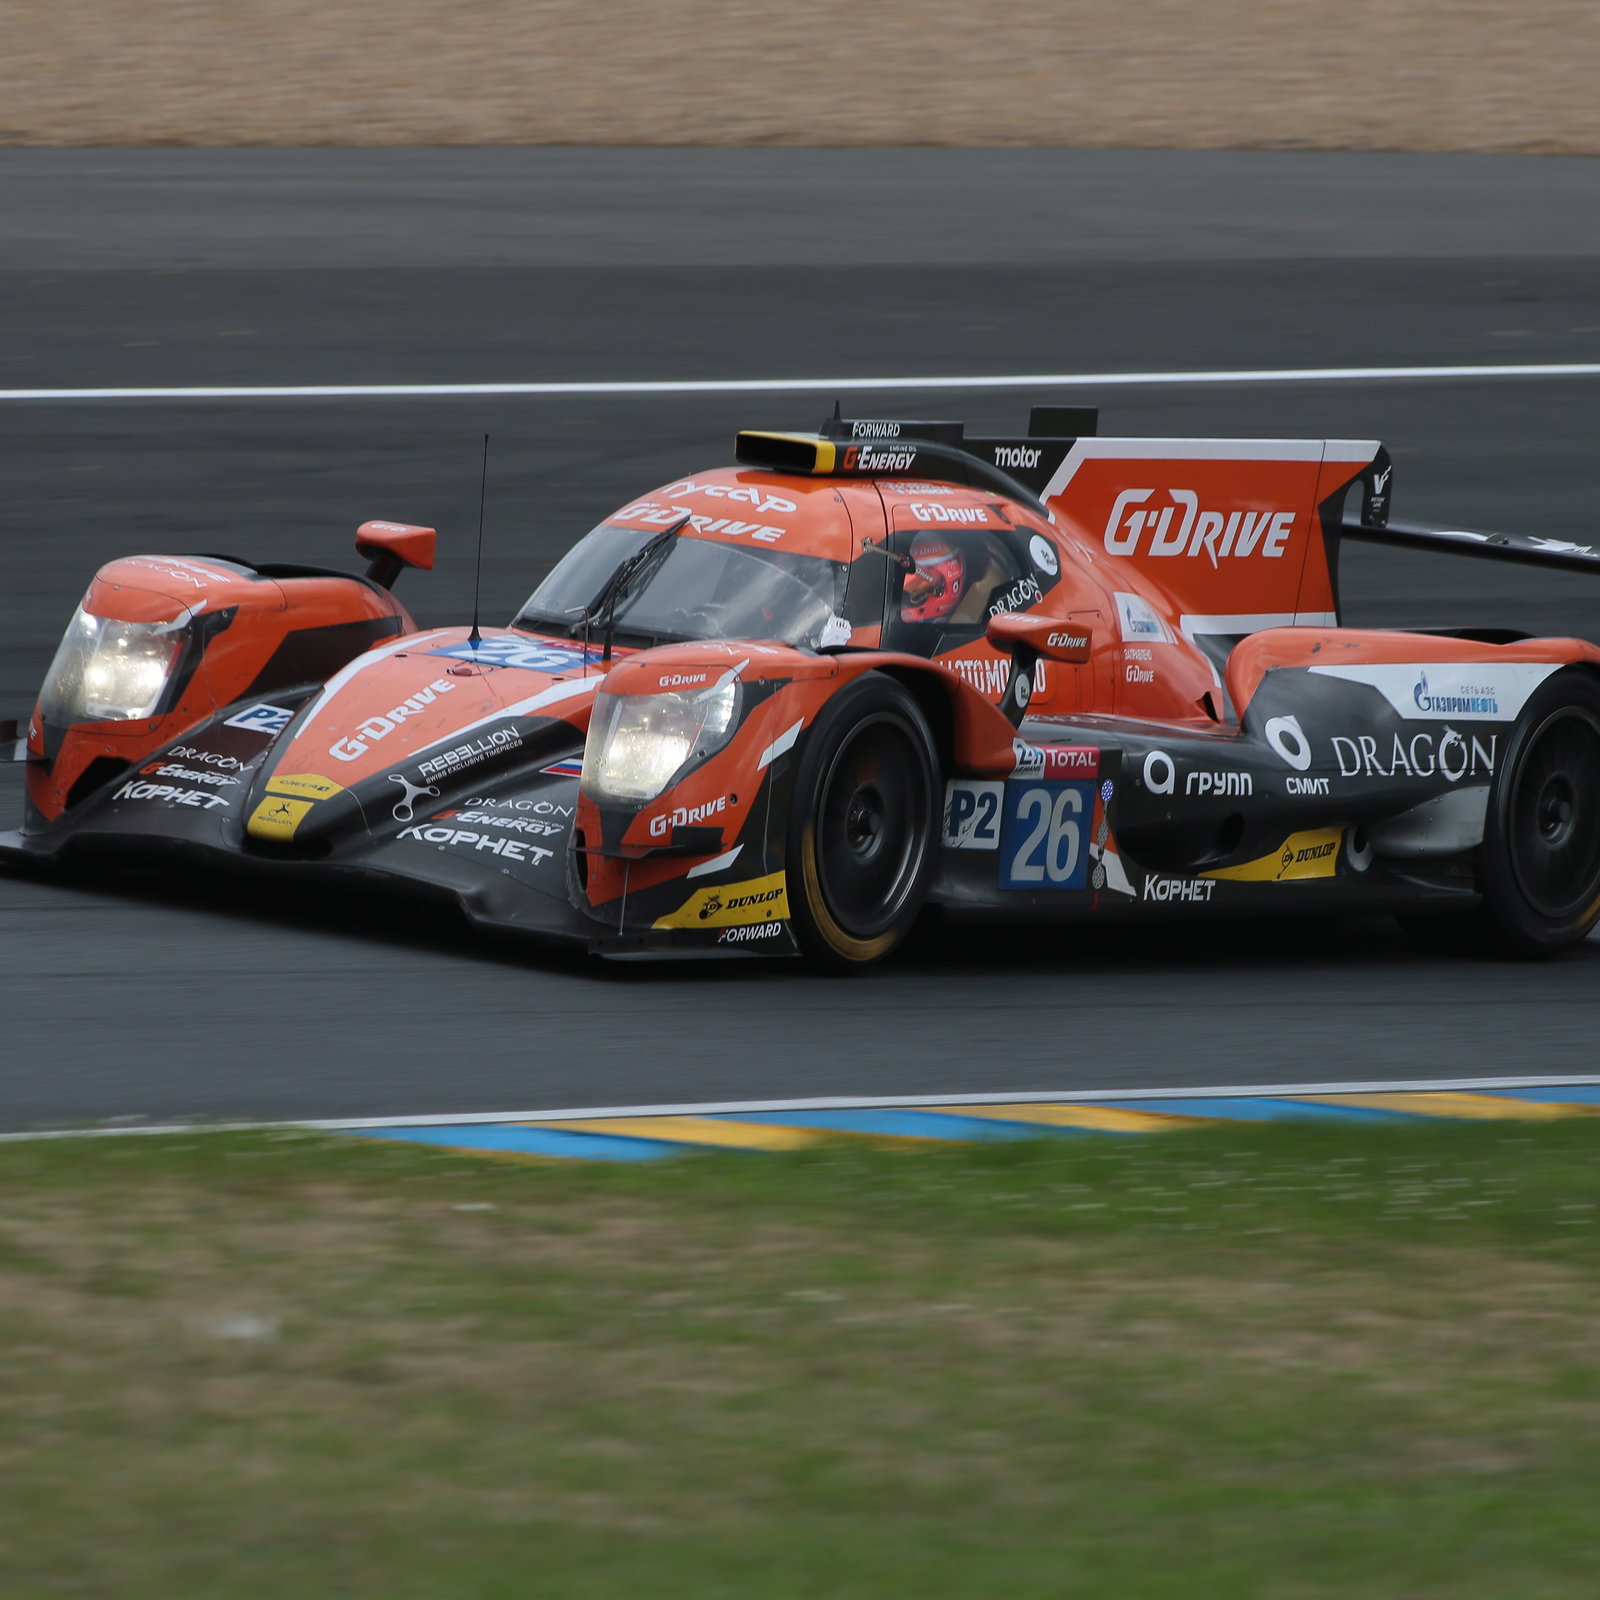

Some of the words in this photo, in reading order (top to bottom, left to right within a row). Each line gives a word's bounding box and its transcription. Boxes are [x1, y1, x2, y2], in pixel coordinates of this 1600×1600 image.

[852, 421, 900, 437] FORWARD
[995, 446, 1041, 468] motor
[989, 572, 1039, 618] DRAGON
[237, 707, 293, 730] P2
[167, 746, 254, 772] DRAGON
[1046, 749, 1097, 767] TOTAL
[1330, 724, 1498, 782] DRAGON
[425, 768, 448, 785] SWISS
[448, 753, 486, 777] EXCLUSIVE
[464, 797, 574, 818] DRAGON
[948, 789, 998, 840] P2
[1010, 788, 1083, 883] 26
[1295, 842, 1337, 863] DUNLOP
[725, 888, 784, 910] DUNLOP
[717, 922, 782, 943] FORWARD
